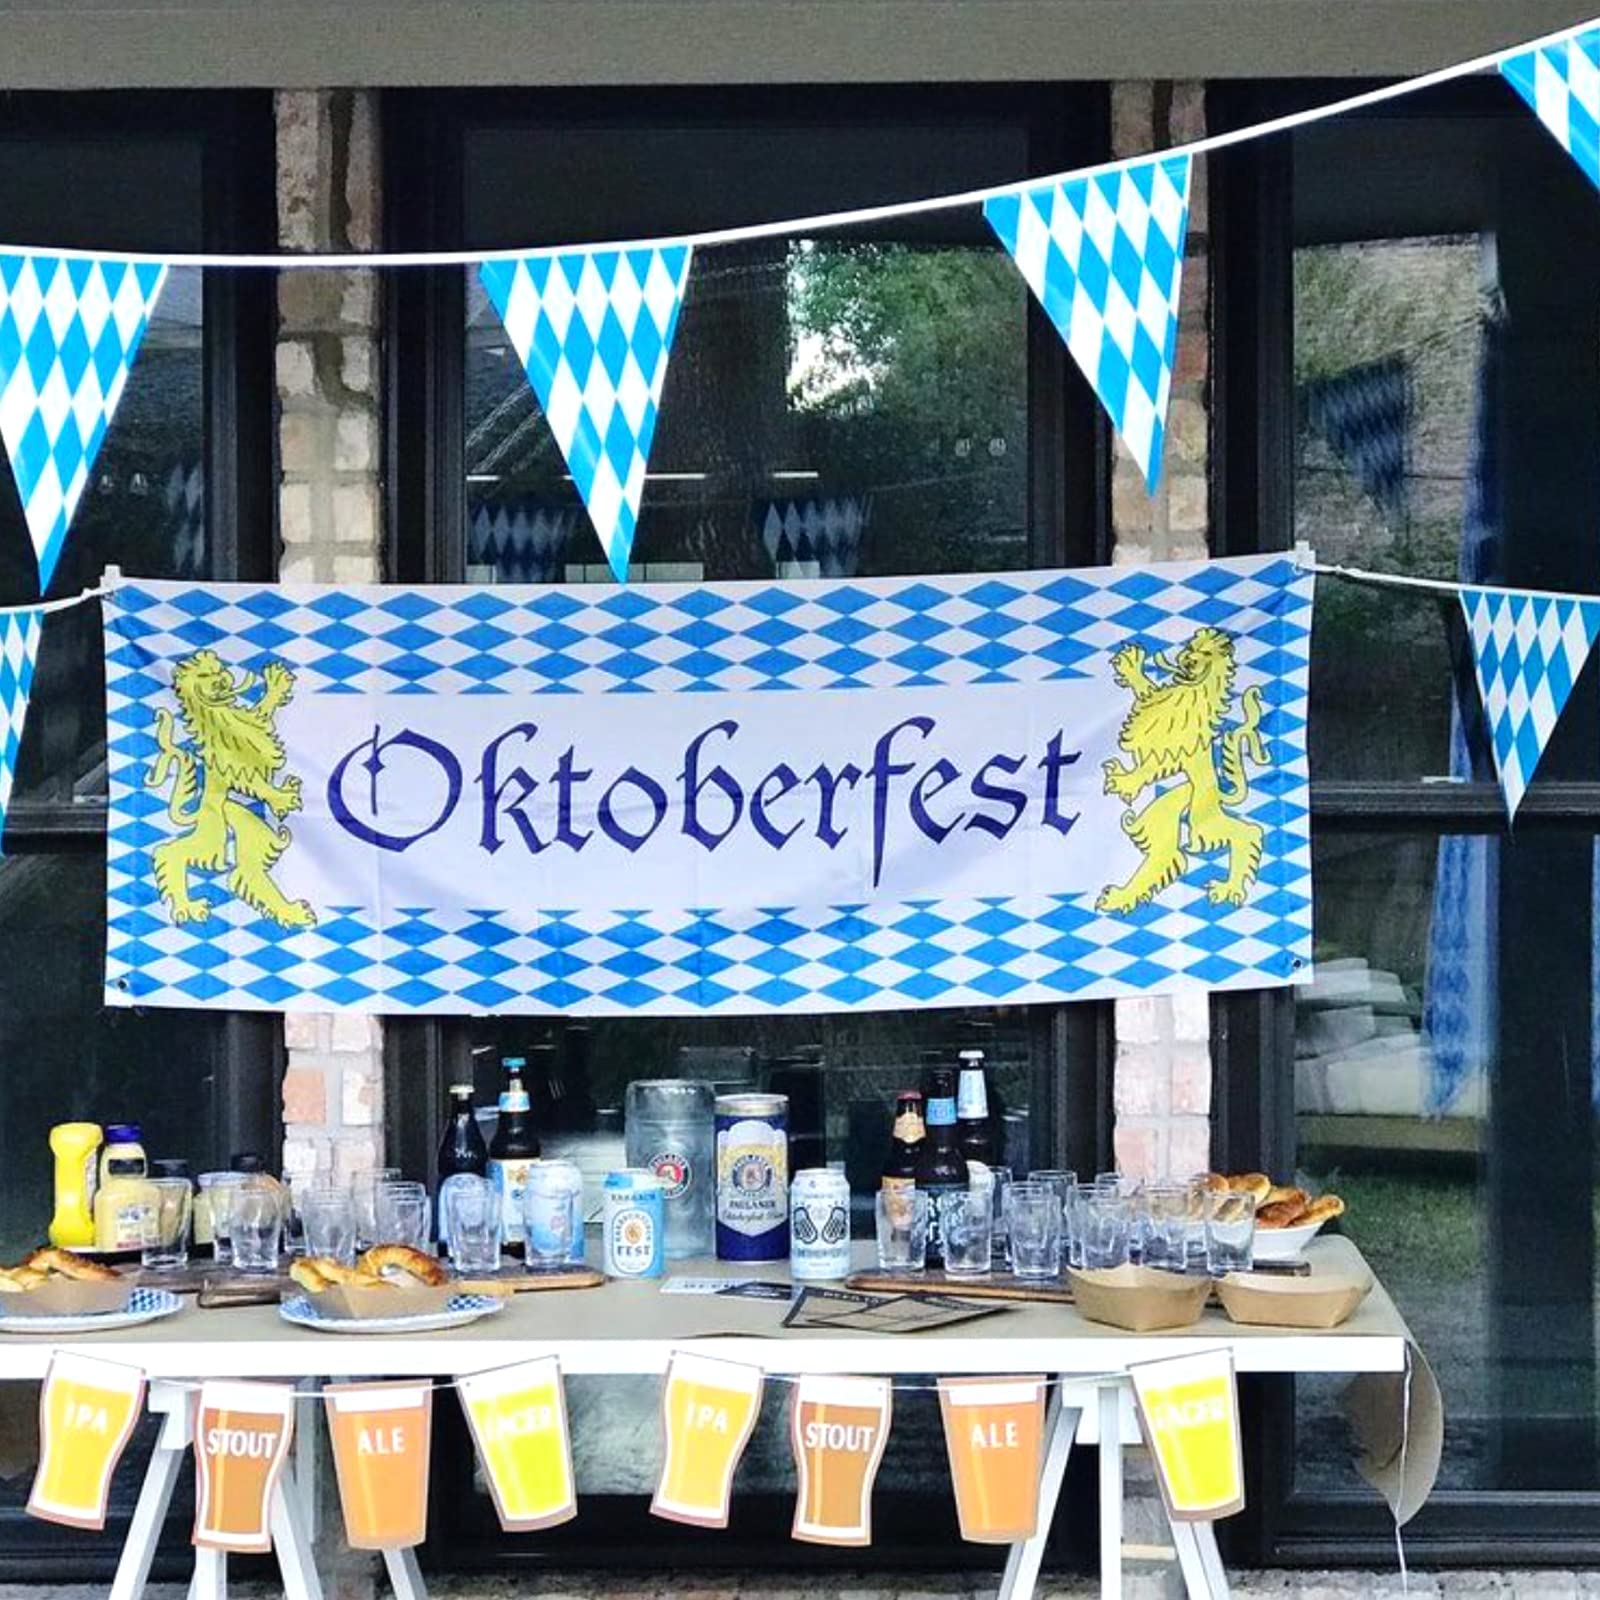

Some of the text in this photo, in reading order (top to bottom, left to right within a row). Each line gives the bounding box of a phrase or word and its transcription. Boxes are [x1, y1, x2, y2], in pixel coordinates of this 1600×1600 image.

[327, 715, 1082, 888] Oktoberfest
[64, 1402, 108, 1435] IPA
[685, 1401, 728, 1433] IPA
[206, 1428, 277, 1459] STOUT
[358, 1427, 406, 1456] ALE
[805, 1423, 875, 1452] STOUT
[970, 1422, 1019, 1449] ALE
